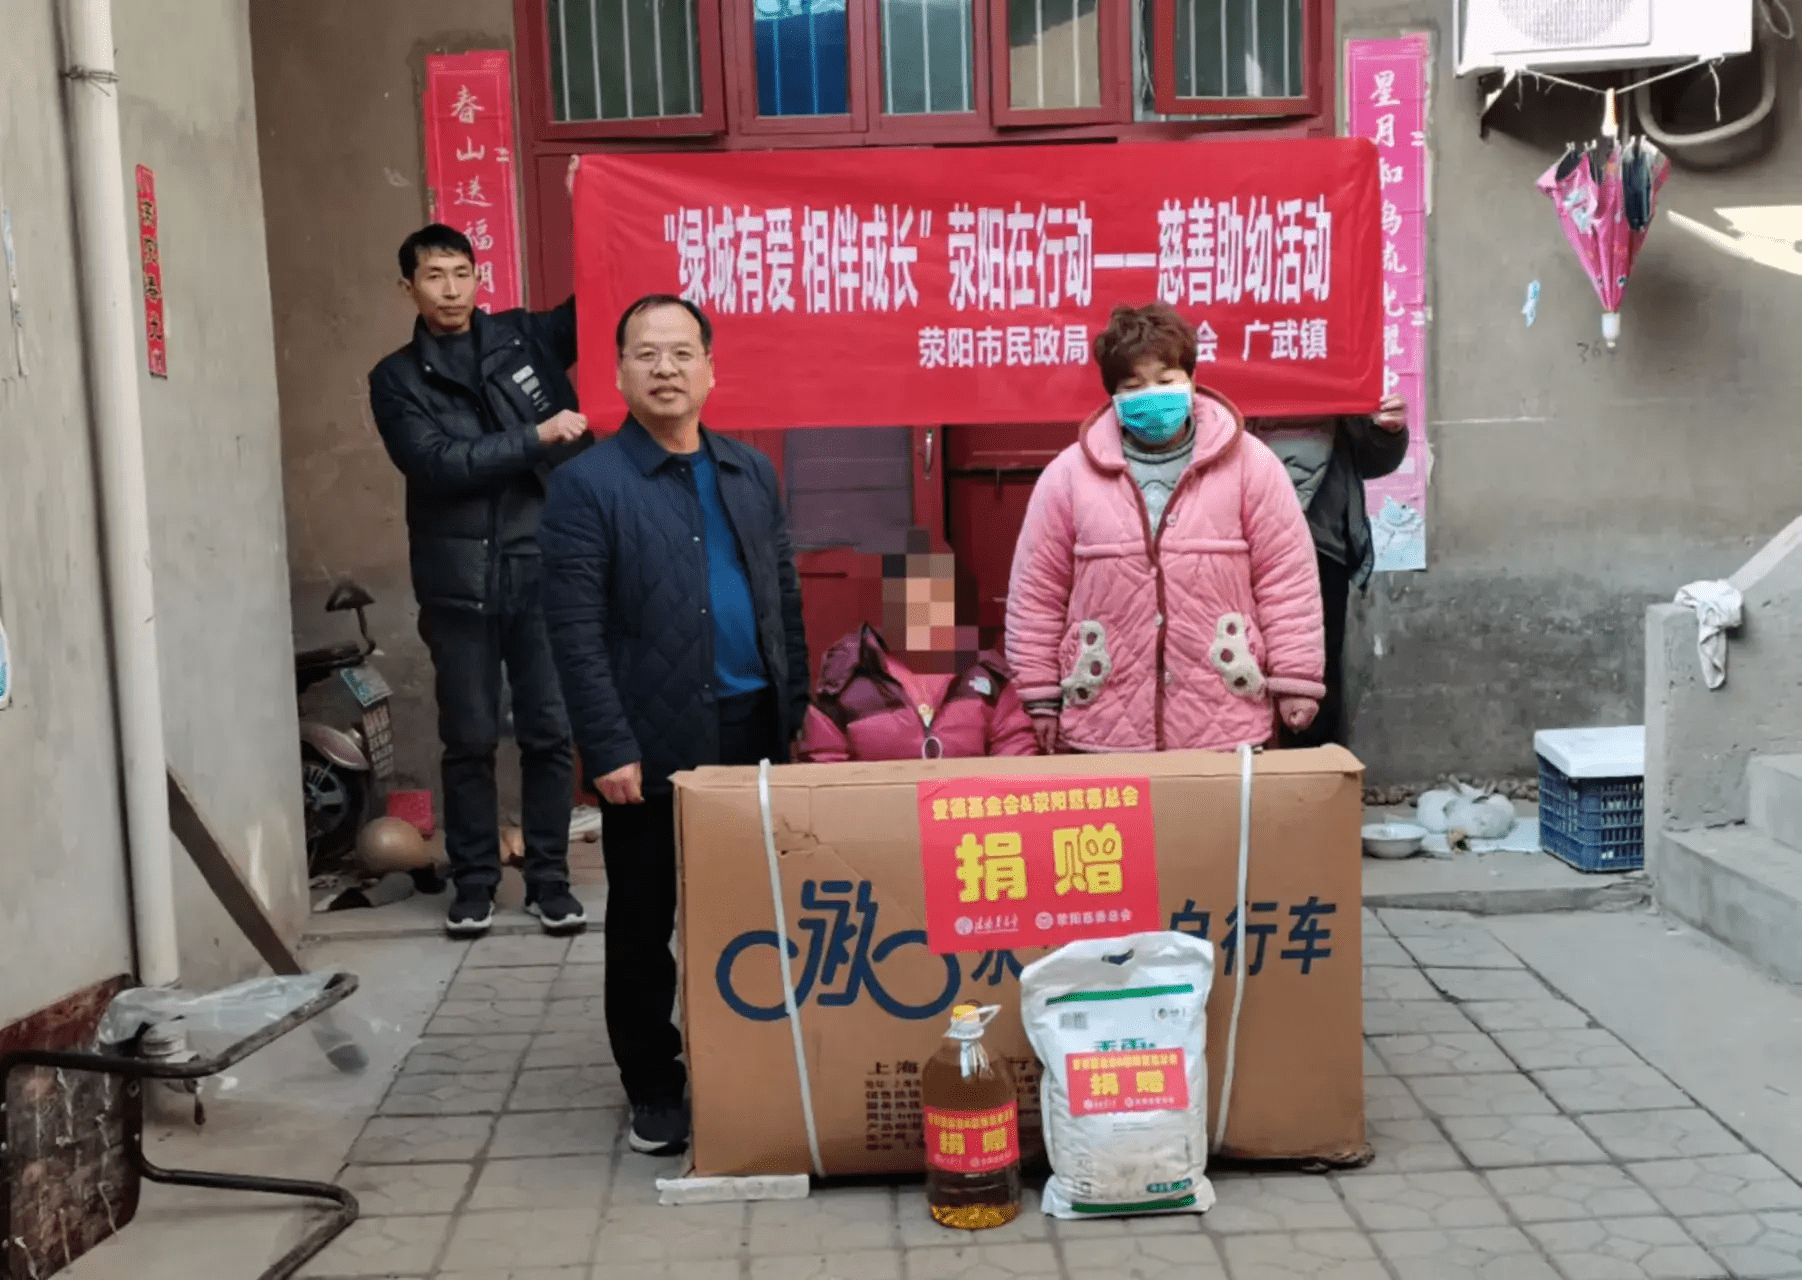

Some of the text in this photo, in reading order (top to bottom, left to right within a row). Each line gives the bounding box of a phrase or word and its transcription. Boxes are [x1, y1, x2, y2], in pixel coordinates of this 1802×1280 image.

[918, 324, 1089, 369] 荥阳市民政局
[1241, 318, 1328, 361] 广武镇
[955, 823, 1124, 903] 捐赠
